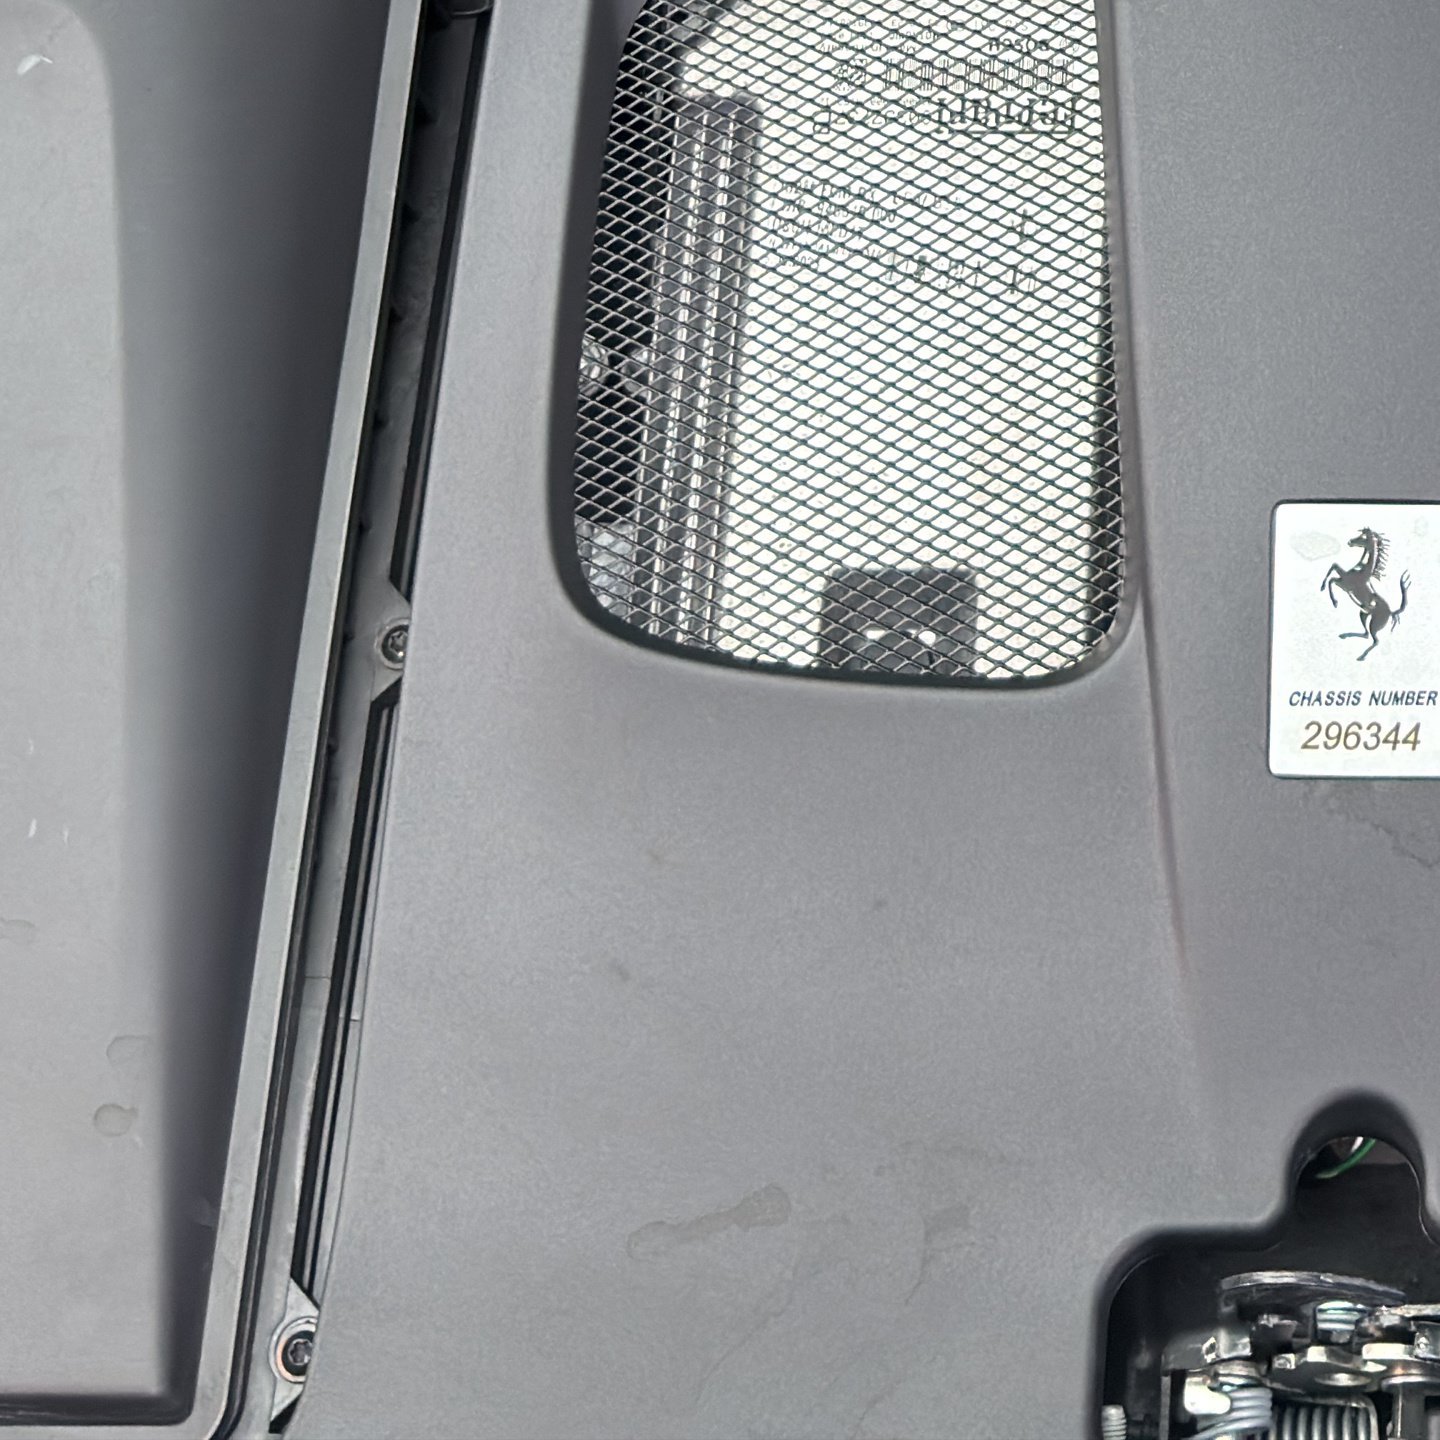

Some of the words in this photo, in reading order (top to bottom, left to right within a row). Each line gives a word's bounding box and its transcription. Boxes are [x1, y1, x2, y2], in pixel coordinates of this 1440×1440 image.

[1289, 690, 1362, 707] CHASSIS
[1368, 690, 1438, 707] NUMBER
[1301, 720, 1421, 751] 296344
